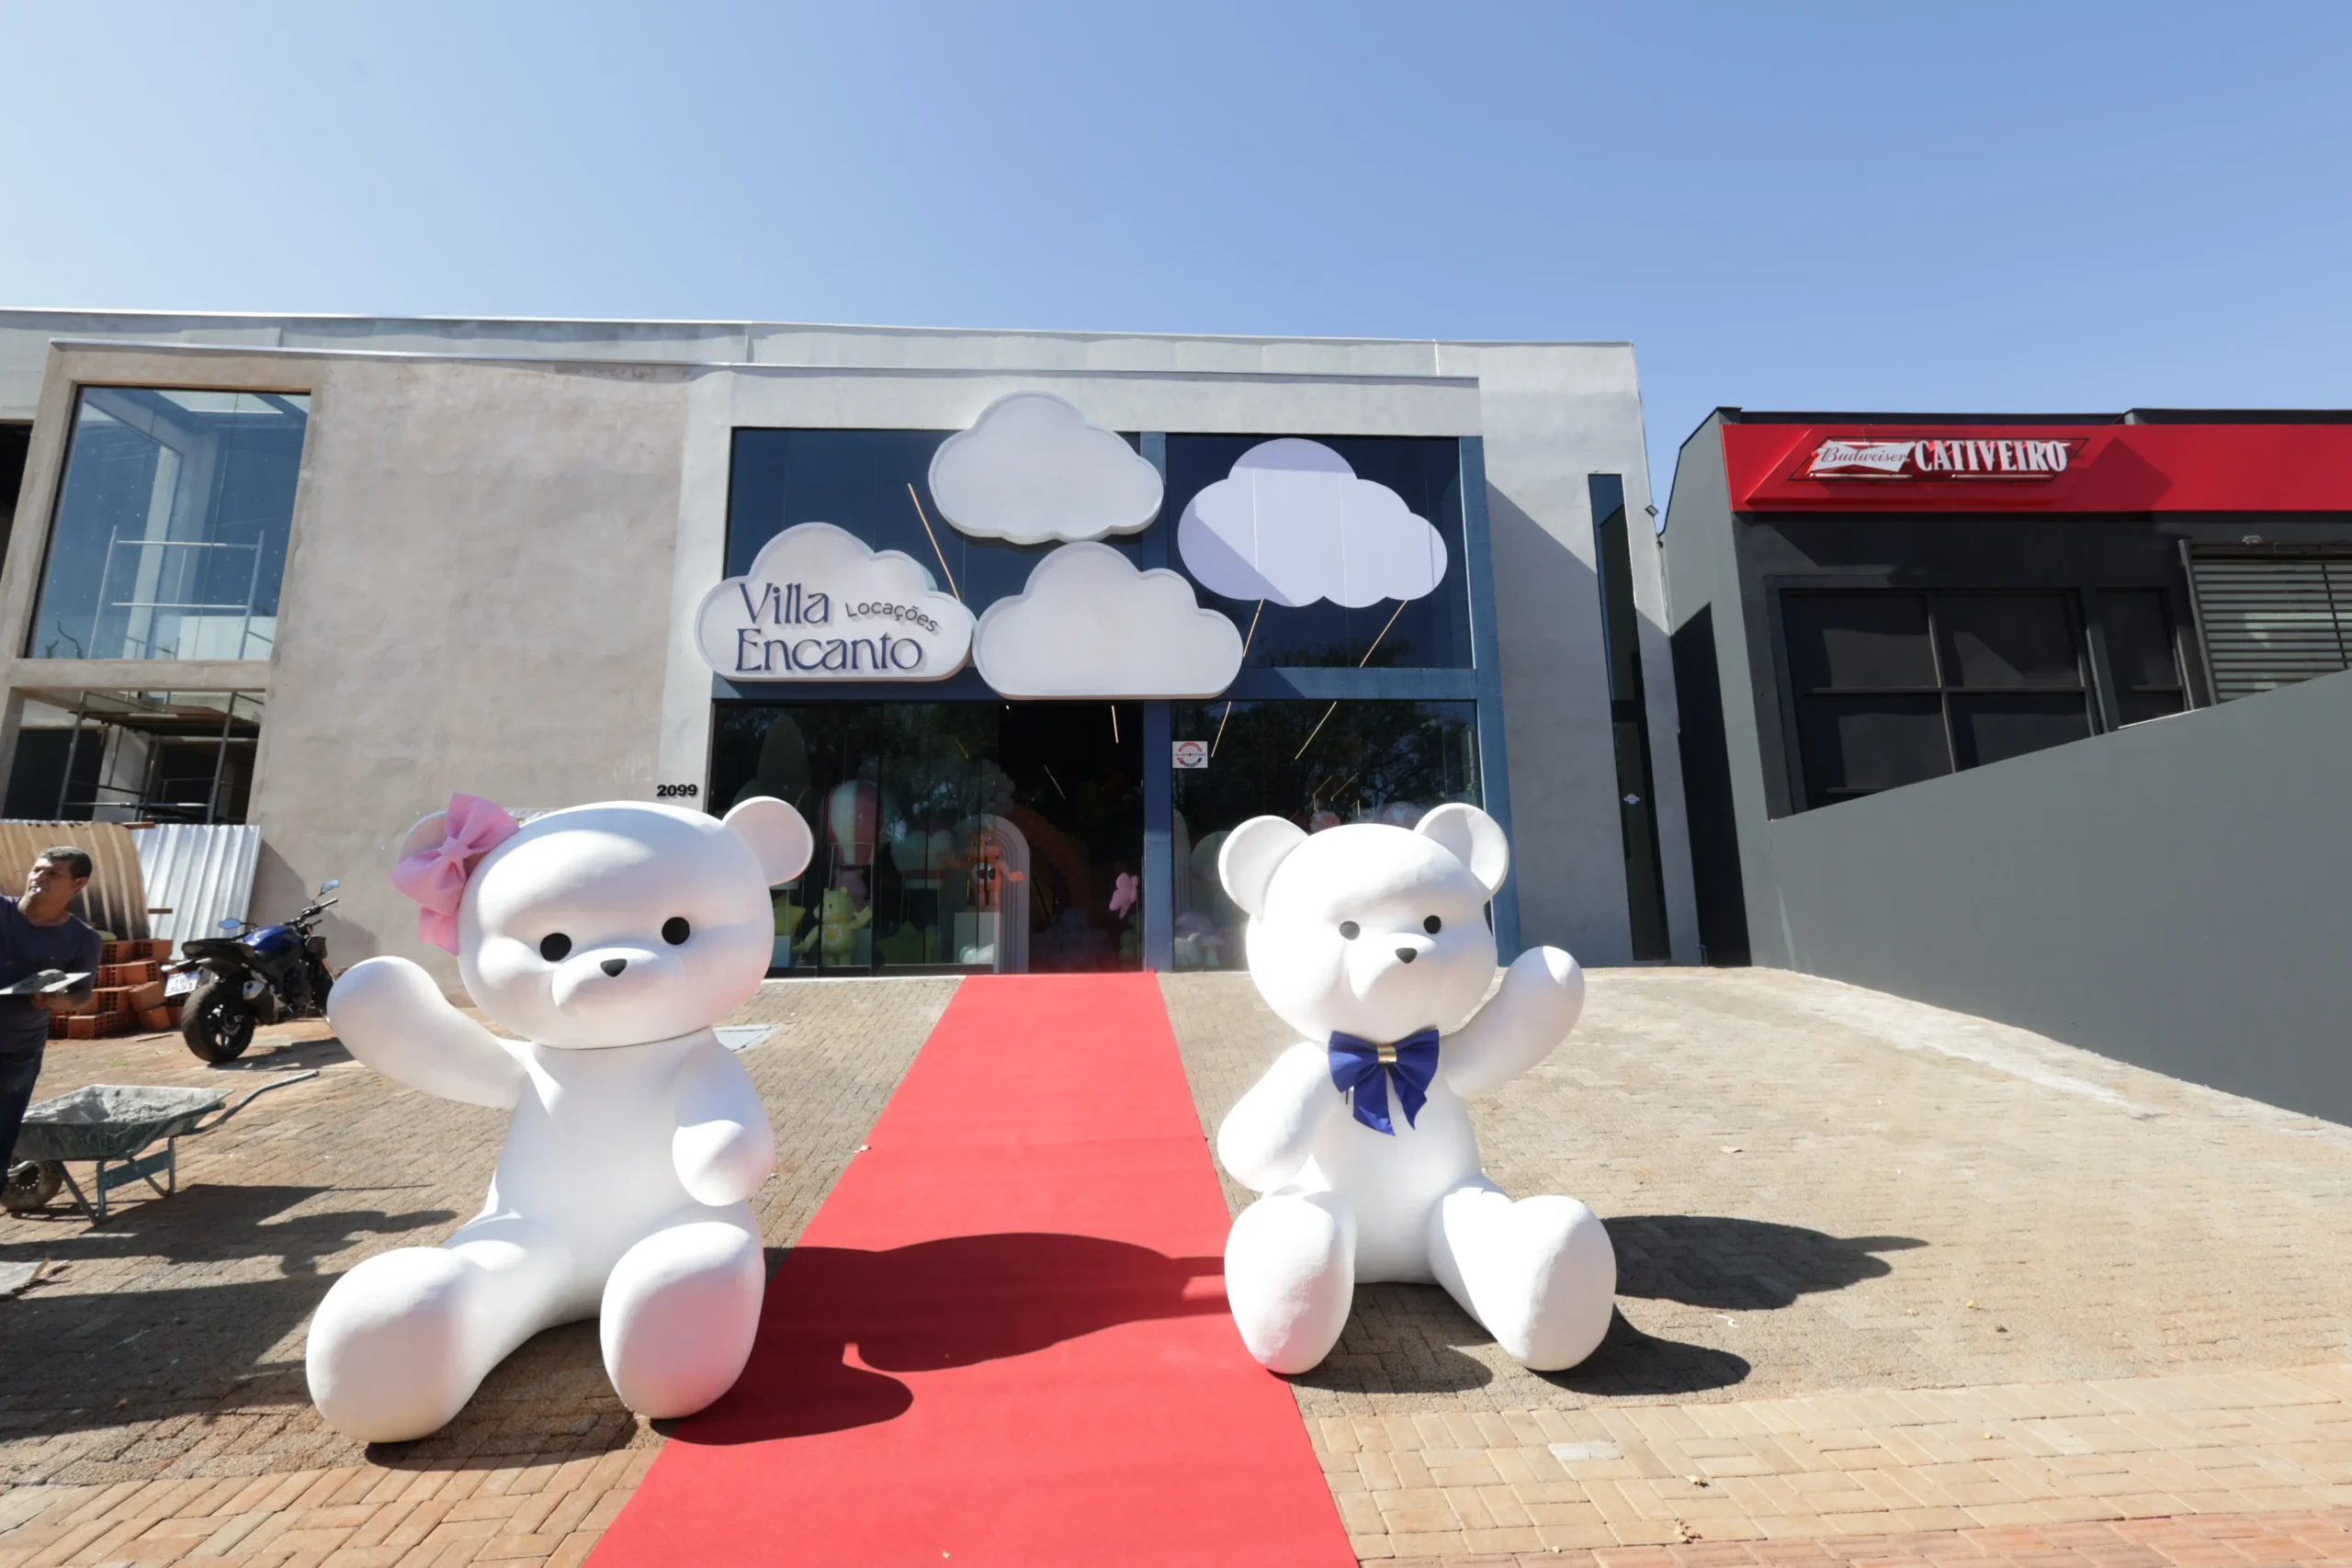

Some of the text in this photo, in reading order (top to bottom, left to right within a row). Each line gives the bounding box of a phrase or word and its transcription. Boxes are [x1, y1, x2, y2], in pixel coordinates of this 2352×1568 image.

[1820, 439, 2068, 472] Budweiser CATIVEIRO
[739, 582, 830, 625] Villa
[844, 602, 939, 633] Locações
[735, 627, 923, 671] Encanto
[656, 784, 698, 797] 2099
